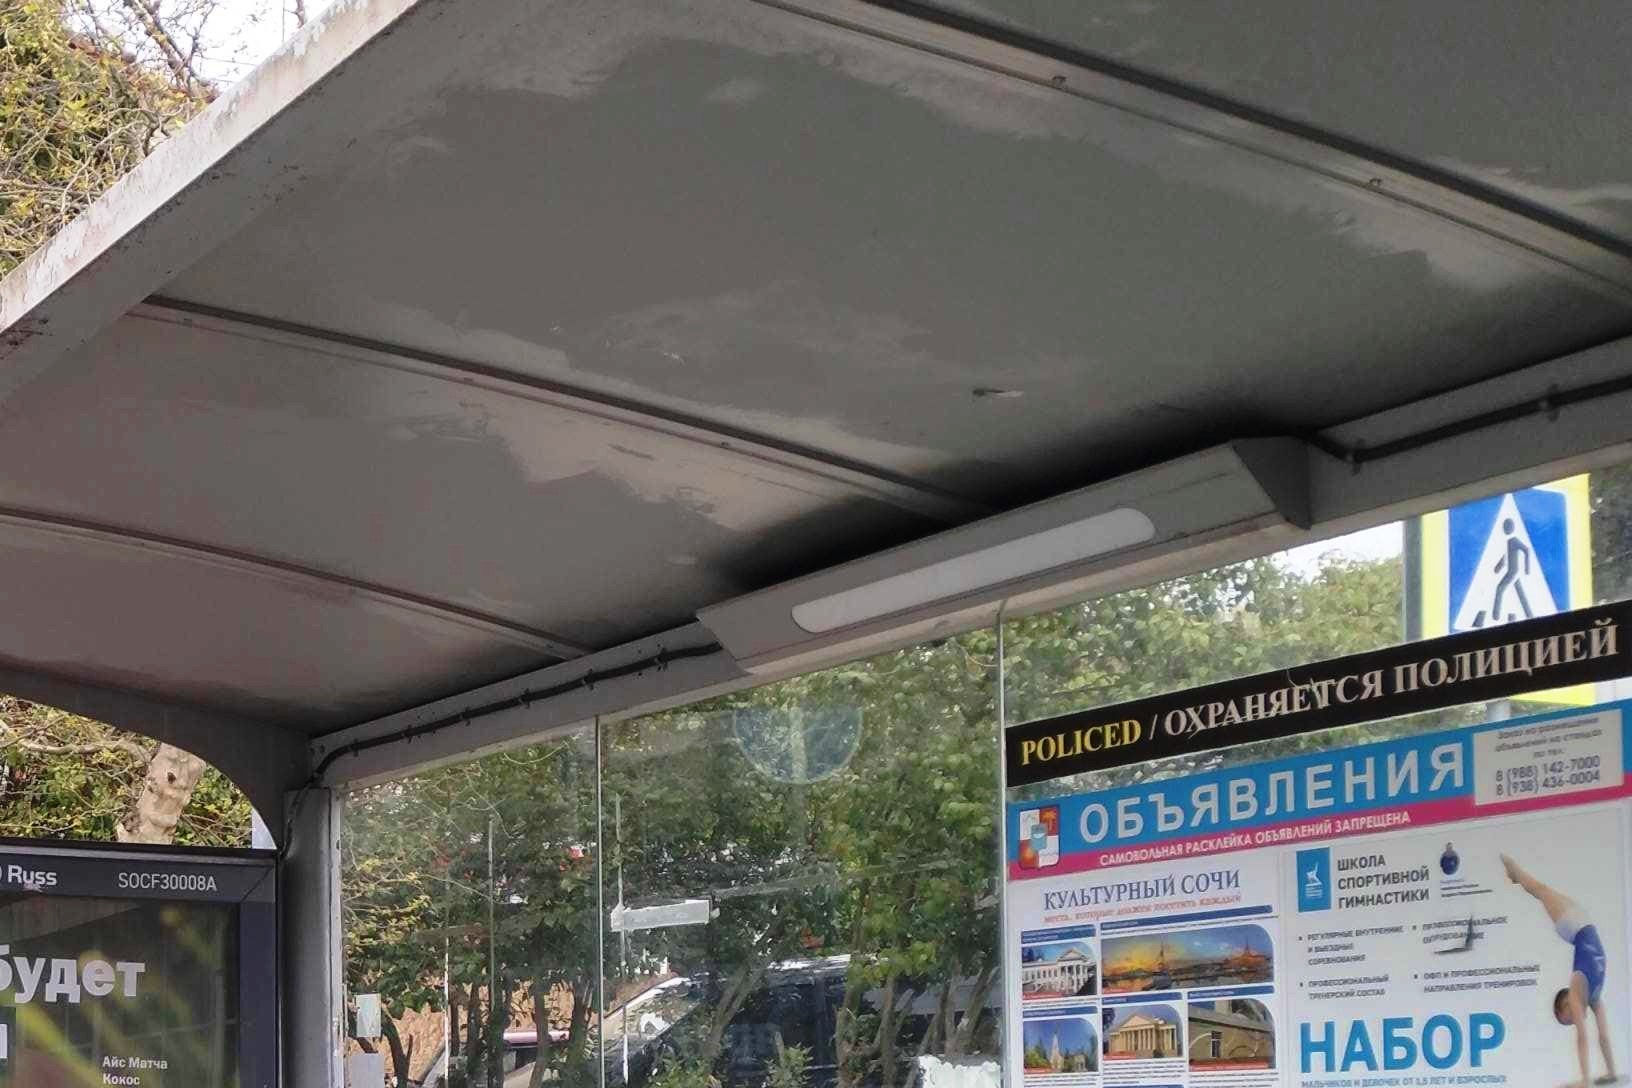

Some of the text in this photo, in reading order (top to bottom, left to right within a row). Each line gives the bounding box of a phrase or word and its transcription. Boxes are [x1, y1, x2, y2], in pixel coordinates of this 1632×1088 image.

[1021, 719, 1141, 766] POLICED
[1164, 670, 1383, 737] ОХРАНЯЕТСЯ
[1395, 618, 1620, 693] ПОЛИЦИЕЙ
[1542, 755, 1600, 774] 142-7000
[1079, 743, 1464, 843] ОБЪЯВЛЕНИЯ
[1099, 811, 1411, 866] САМОВОЛЬНАЯ РАСКЛЕЙКА ОБЪЯВЛЕНИЙ ЗАПРЕЩЕНА
[1337, 854, 1386, 871] ШКОЛА
[8, 864, 57, 886] Russ
[118, 872, 217, 891] SOCF30008A
[1337, 865, 1430, 890] СПОРТИВНОЙ
[1043, 869, 1241, 911] КУЛЬТУРНЫЙ СОЧИ
[1338, 888, 1430, 910] ГИМНАСТИКИ
[1300, 1012, 1506, 1074] НАБОР
[102, 1054, 169, 1070] Айс Матча
[102, 1073, 141, 1086] Кокос
[1361, 1077, 1401, 1088] ДЕВОЧЕК
[1403, 1077, 1414, 1086] ОТ
[1430, 1076, 1447, 1085] ЛЕТ
